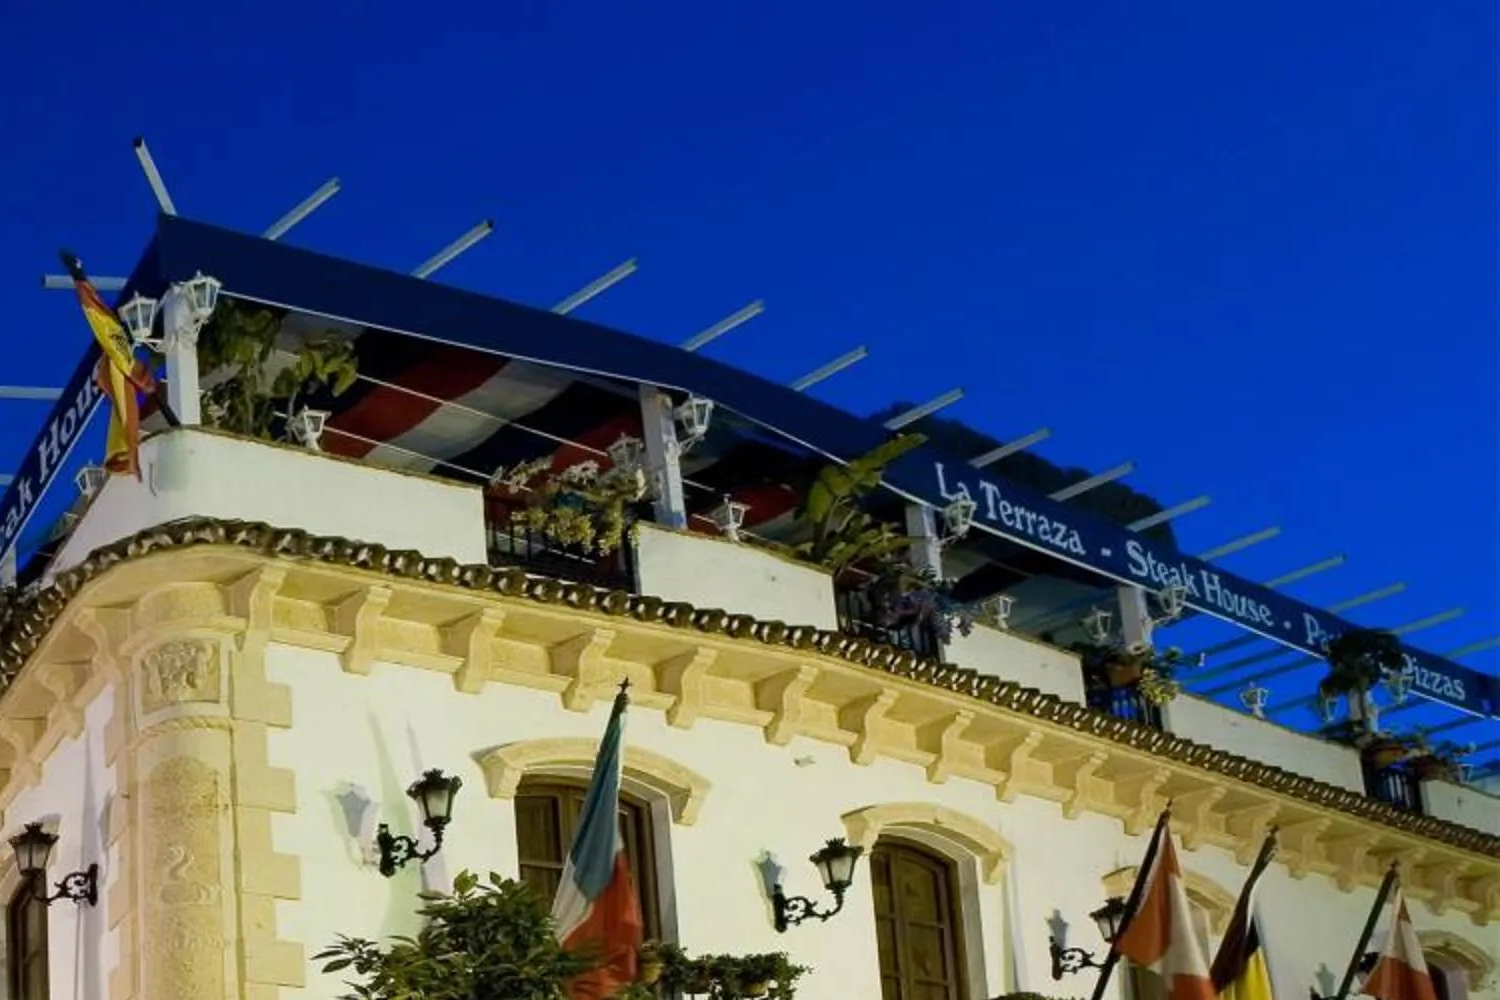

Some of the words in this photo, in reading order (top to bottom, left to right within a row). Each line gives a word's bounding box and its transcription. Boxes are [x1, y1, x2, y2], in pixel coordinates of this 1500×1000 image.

[38, 357, 104, 484] Hous
[934, 462, 973, 505] La
[979, 479, 1087, 555] Terraza
[1125, 539, 1201, 600] Steak
[1199, 569, 1275, 626] House
